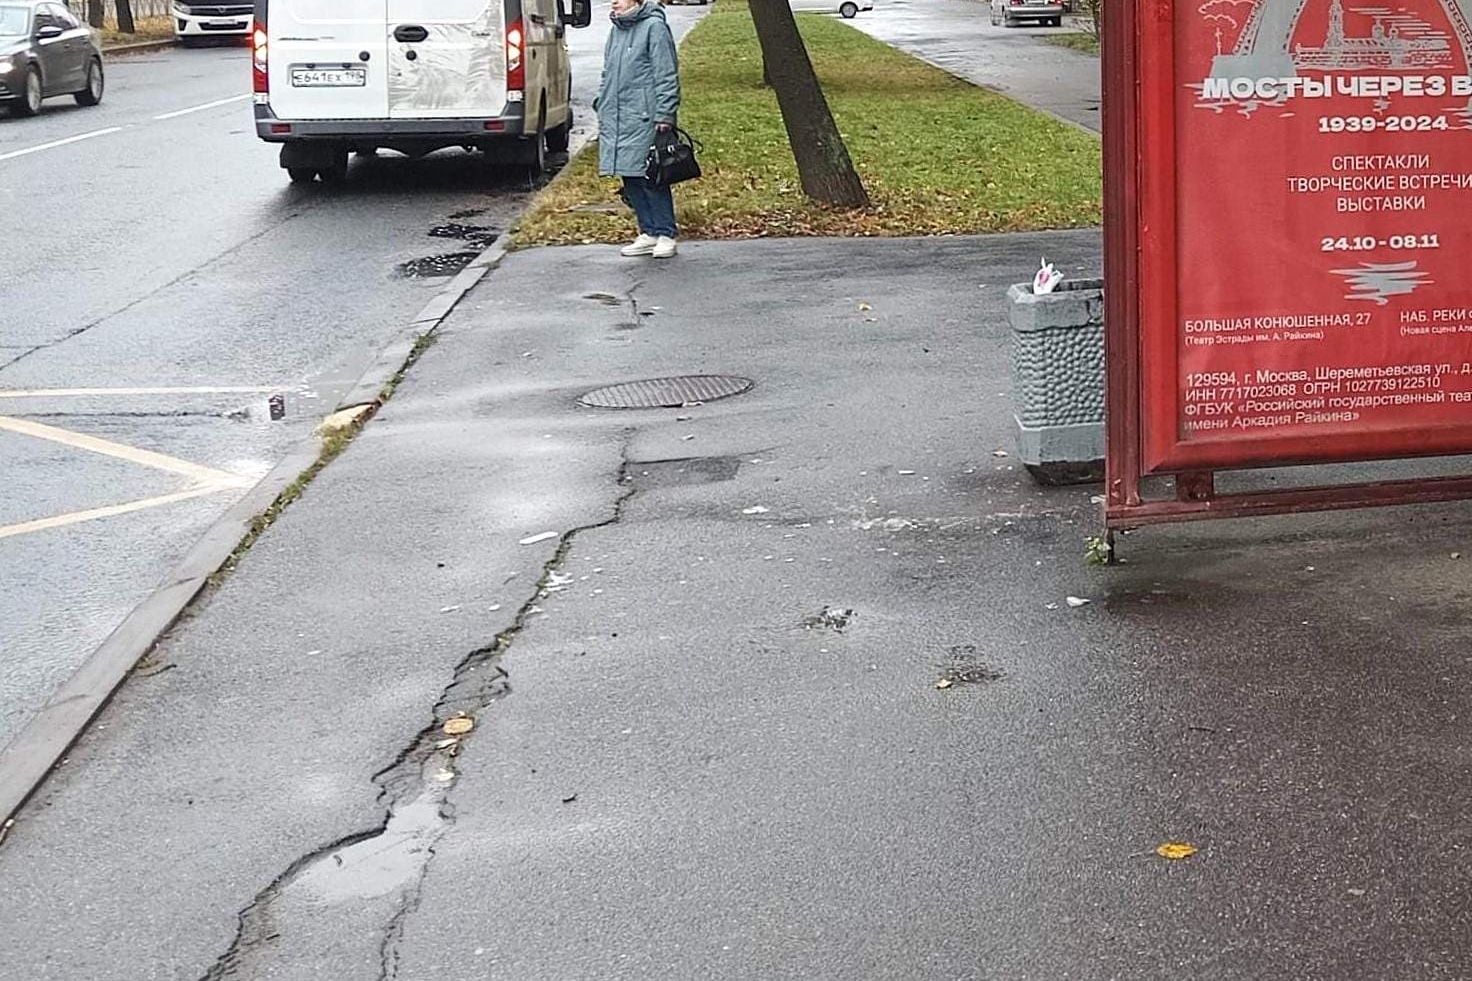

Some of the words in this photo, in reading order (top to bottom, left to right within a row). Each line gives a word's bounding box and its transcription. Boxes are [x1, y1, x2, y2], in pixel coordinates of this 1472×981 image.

[1202, 74, 1331, 100] МОСТЫ
[1337, 74, 1447, 99] ЧЕРЕЗ
[1318, 115, 1449, 133] 1939-2024
[1331, 154, 1430, 171] СПЕКТАКЛИ
[1287, 175, 1395, 193] ТВОРЧЕСКИЕ
[1336, 196, 1426, 212] ВЫСТАВКИ
[1321, 235, 1376, 252] 24.10
[1389, 234, 1440, 250] 08.11
[1184, 317, 1252, 333] БОЛЬШАЯ
[1254, 314, 1354, 330] КОНЮШЕННАЯ,
[1356, 312, 1372, 325] 27
[1400, 310, 1429, 323] НАБ.
[1433, 309, 1466, 322] РЕКИ
[1186, 372, 1240, 387] 129594,
[1256, 369, 1311, 383] Москва,
[1315, 363, 1431, 382] Шереметьевская
[1184, 388, 1216, 402] ИНН
[1219, 384, 1297, 400] 7717023068
[1303, 380, 1340, 395] ОГРН
[1344, 376, 1441, 393] 1027739122510
[1184, 402, 1234, 416] ФГБУК
[1237, 396, 1325, 413] «Российский
[1328, 389, 1445, 409] государственный
[1184, 417, 1229, 431] имени
[1231, 413, 1291, 430] Аркадия
[1294, 408, 1360, 425] Райкина»
